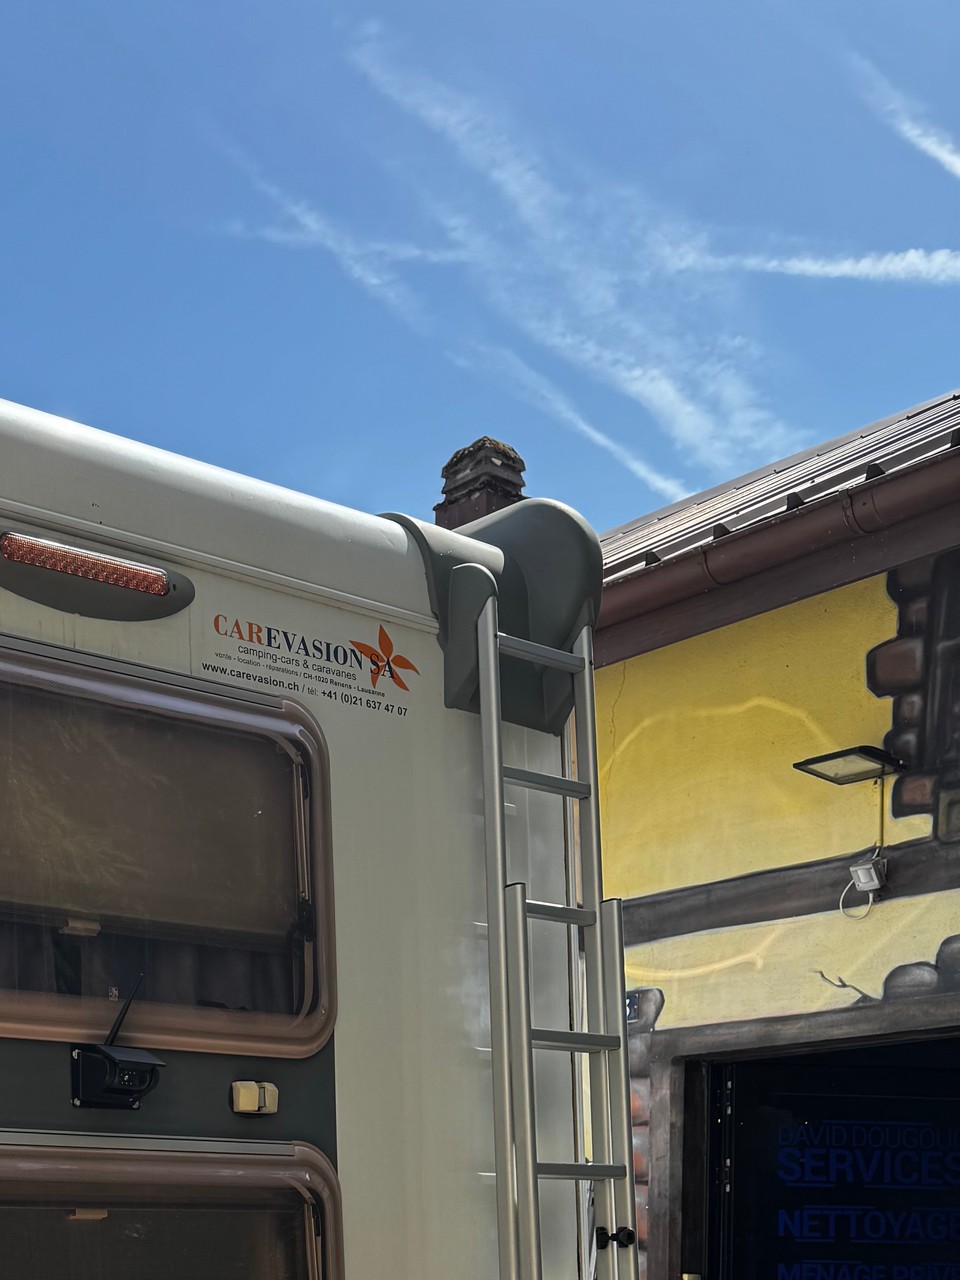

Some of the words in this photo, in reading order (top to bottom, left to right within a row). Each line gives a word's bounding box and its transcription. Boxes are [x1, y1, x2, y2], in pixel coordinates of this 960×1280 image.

[213, 614, 363, 671] CAREVASION
[369, 652, 396, 680] SA
[237, 645, 300, 668] camping-cars
[302, 660, 310, 670] &
[311, 663, 357, 681] caravanes
[201, 662, 300, 692] www.carevasion.ch
[321, 690, 338, 701] +41
[340, 691, 363, 706] (0)21
[366, 700, 382, 711] 637
[384, 704, 395, 714] 47
[397, 707, 408, 717] 07
[237, 656, 261, 668] location
[303, 672, 329, 684] CH-1020
[357, 685, 386, 698] Lausanne
[778, 1125, 847, 1147] DAVID
[777, 1148, 960, 1184] SERVICES
[778, 1209, 960, 1240] NETTOYAGE
